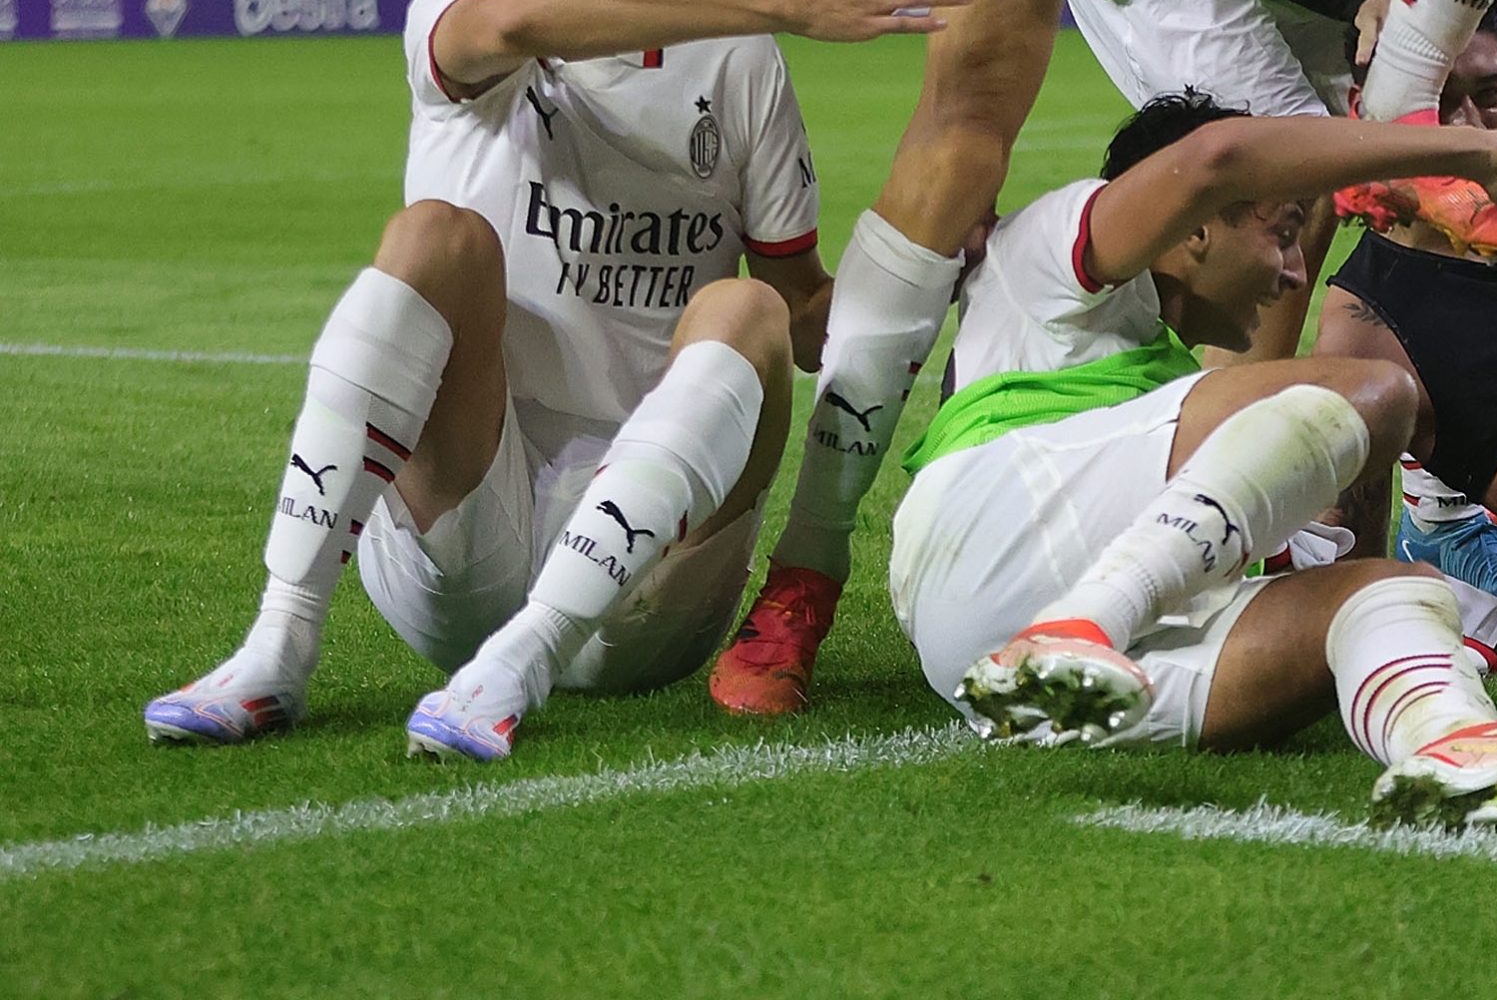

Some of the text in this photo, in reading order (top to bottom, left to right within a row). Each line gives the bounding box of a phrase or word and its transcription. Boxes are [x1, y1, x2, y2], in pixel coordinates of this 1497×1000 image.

[525, 180, 724, 256] Emirates
[593, 265, 695, 307] BETTER
[559, 530, 632, 587] MILAN
